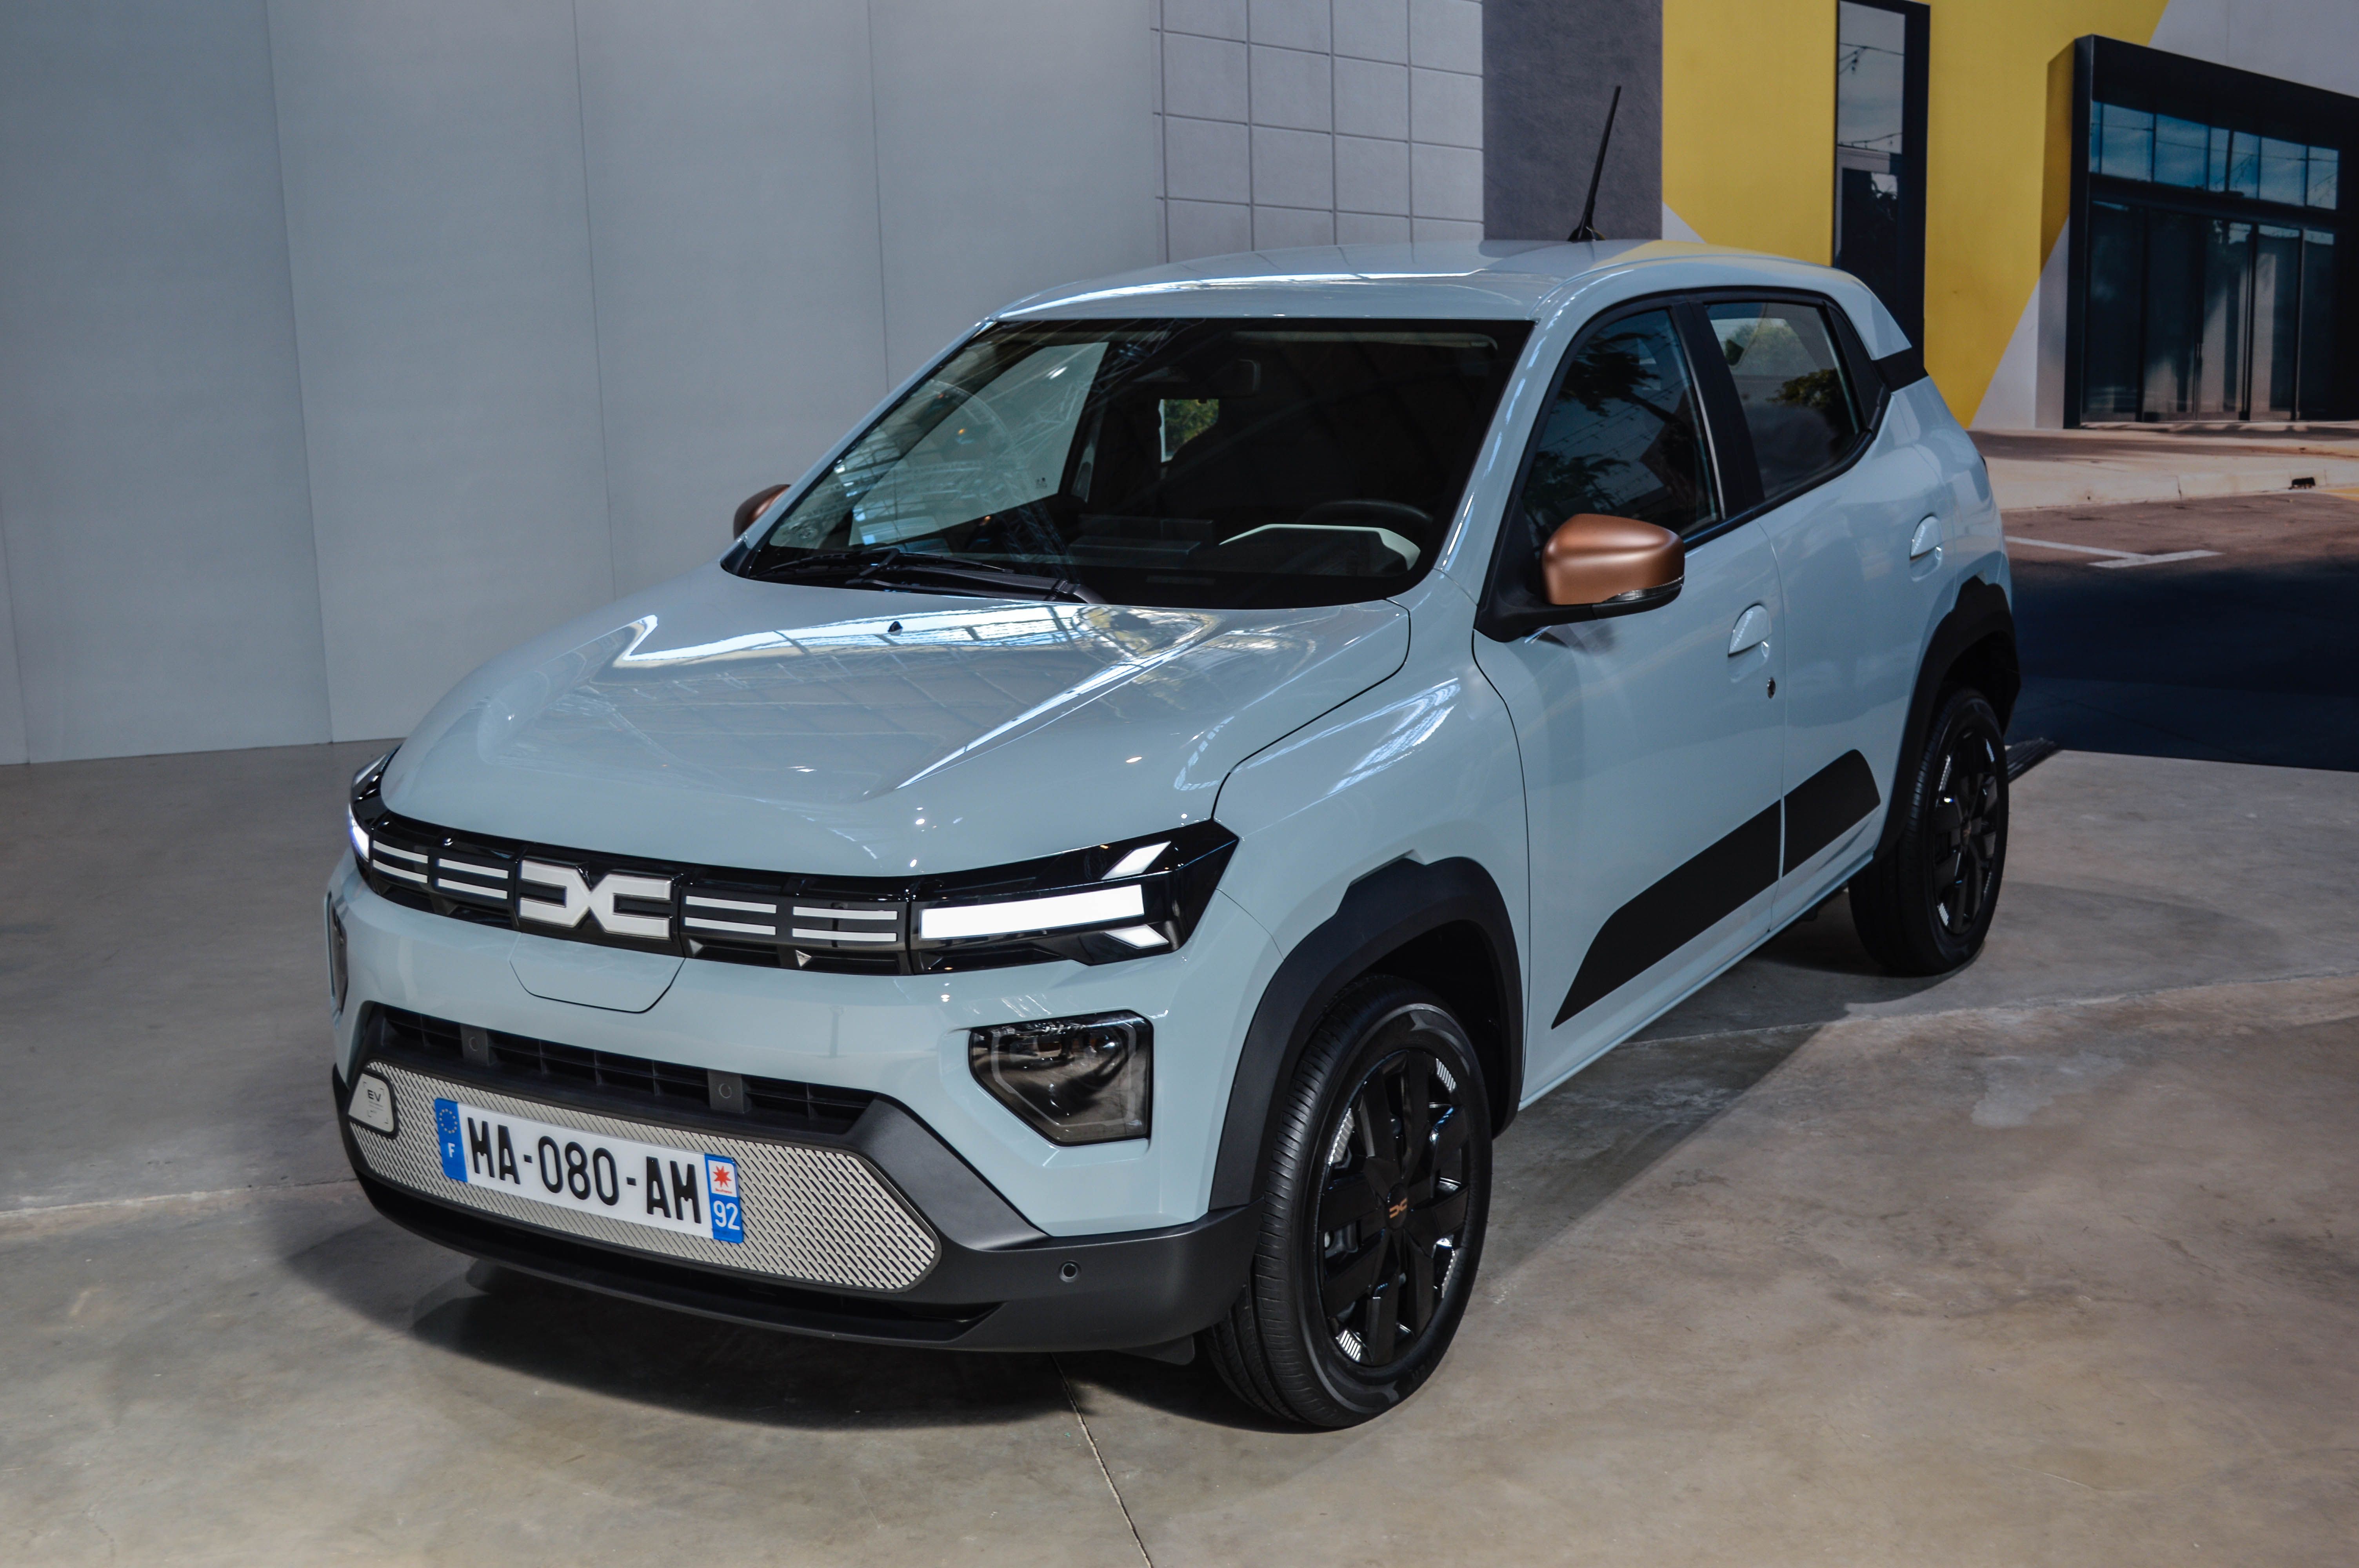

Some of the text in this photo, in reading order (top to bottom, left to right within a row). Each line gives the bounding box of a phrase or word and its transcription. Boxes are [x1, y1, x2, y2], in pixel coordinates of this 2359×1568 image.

[367, 1089, 382, 1102] EV
[447, 1142, 456, 1158] F
[467, 1117, 702, 1224] MA-080-AM
[713, 1200, 741, 1230] 92
